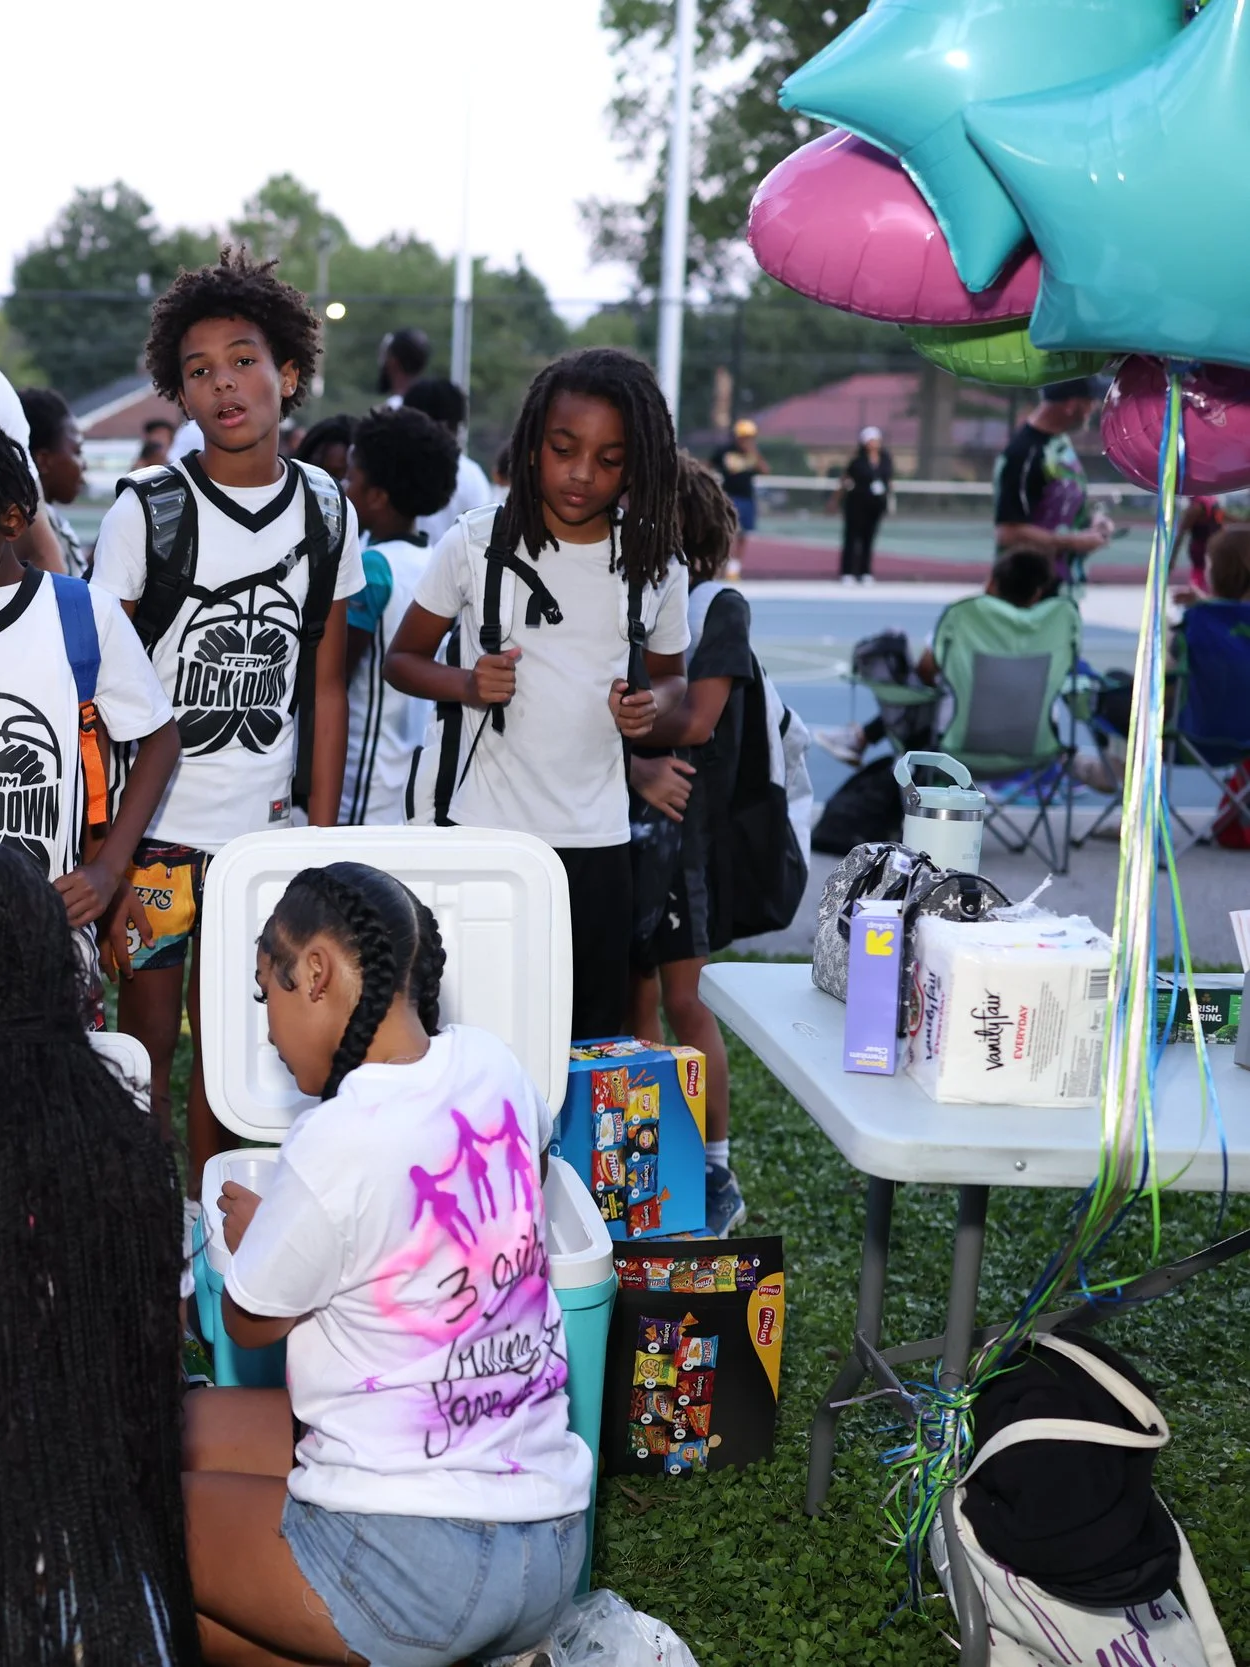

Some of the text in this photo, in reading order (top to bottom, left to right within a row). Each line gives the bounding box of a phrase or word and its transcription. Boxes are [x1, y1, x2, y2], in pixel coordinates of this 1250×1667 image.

[224, 656, 269, 668] TEAM
[1195, 1004, 1219, 1013] RISH
[1186, 1013, 1223, 1022] SRING
[1013, 1005, 1029, 1060] EVERYDAY
[437, 1266, 478, 1323] 3
